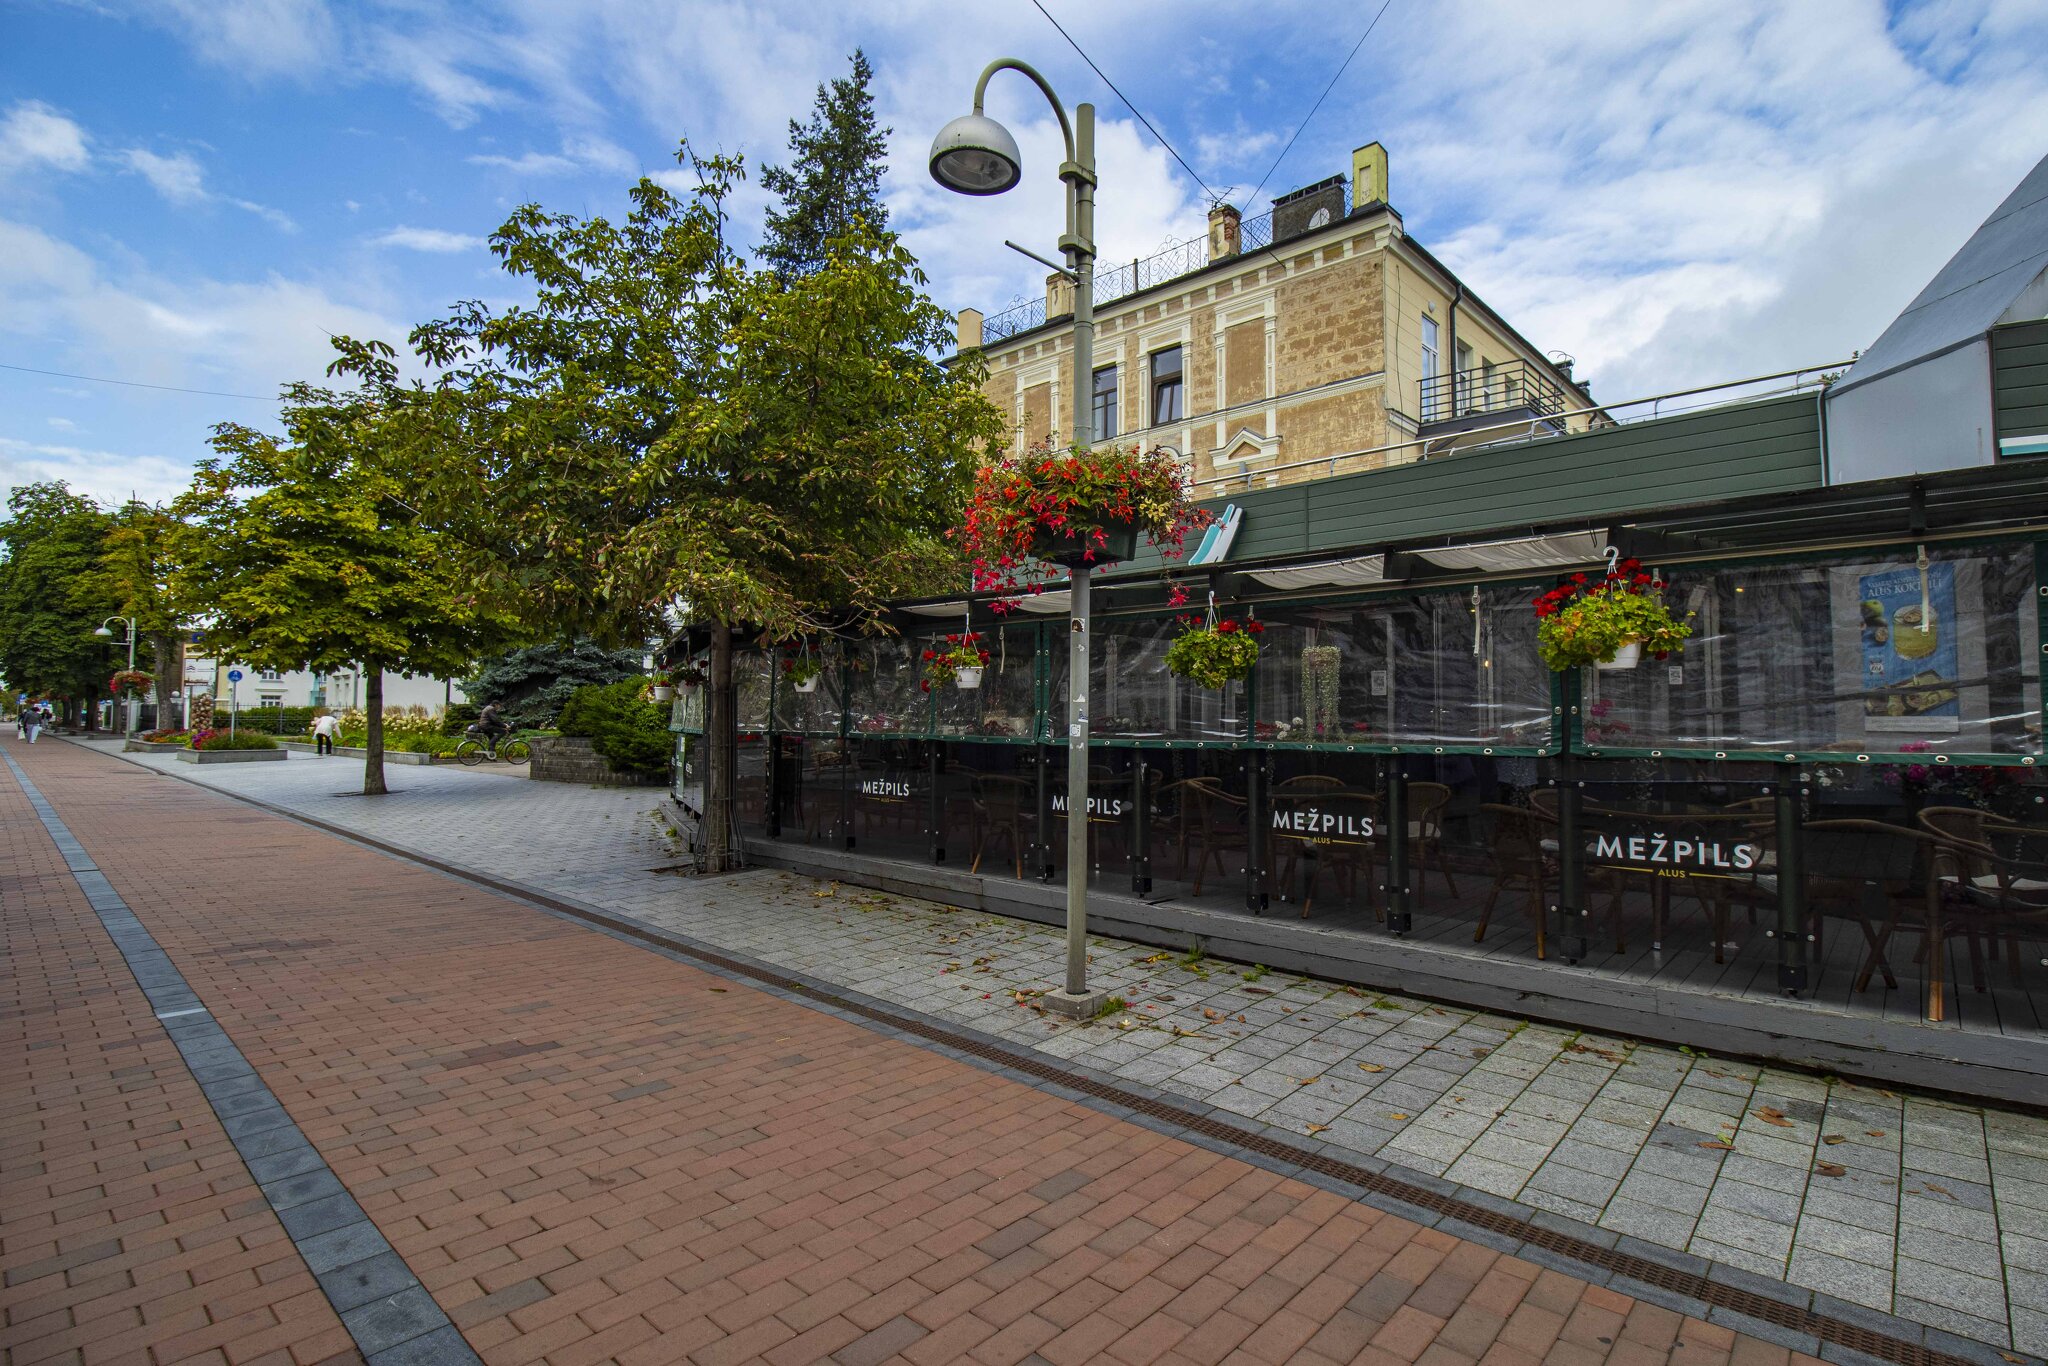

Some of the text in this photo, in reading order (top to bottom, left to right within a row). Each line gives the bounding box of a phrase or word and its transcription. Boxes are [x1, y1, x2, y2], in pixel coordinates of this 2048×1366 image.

[1868, 587, 1892, 598] ALUS
[862, 778, 910, 797] MEŽPILS
[1052, 795, 1121, 816] MPILS
[1272, 808, 1374, 836] MEŽPILS
[1312, 836, 1331, 845] ALUS
[1596, 832, 1753, 869] MEŽPILS
[1657, 868, 1686, 879] ALUS
